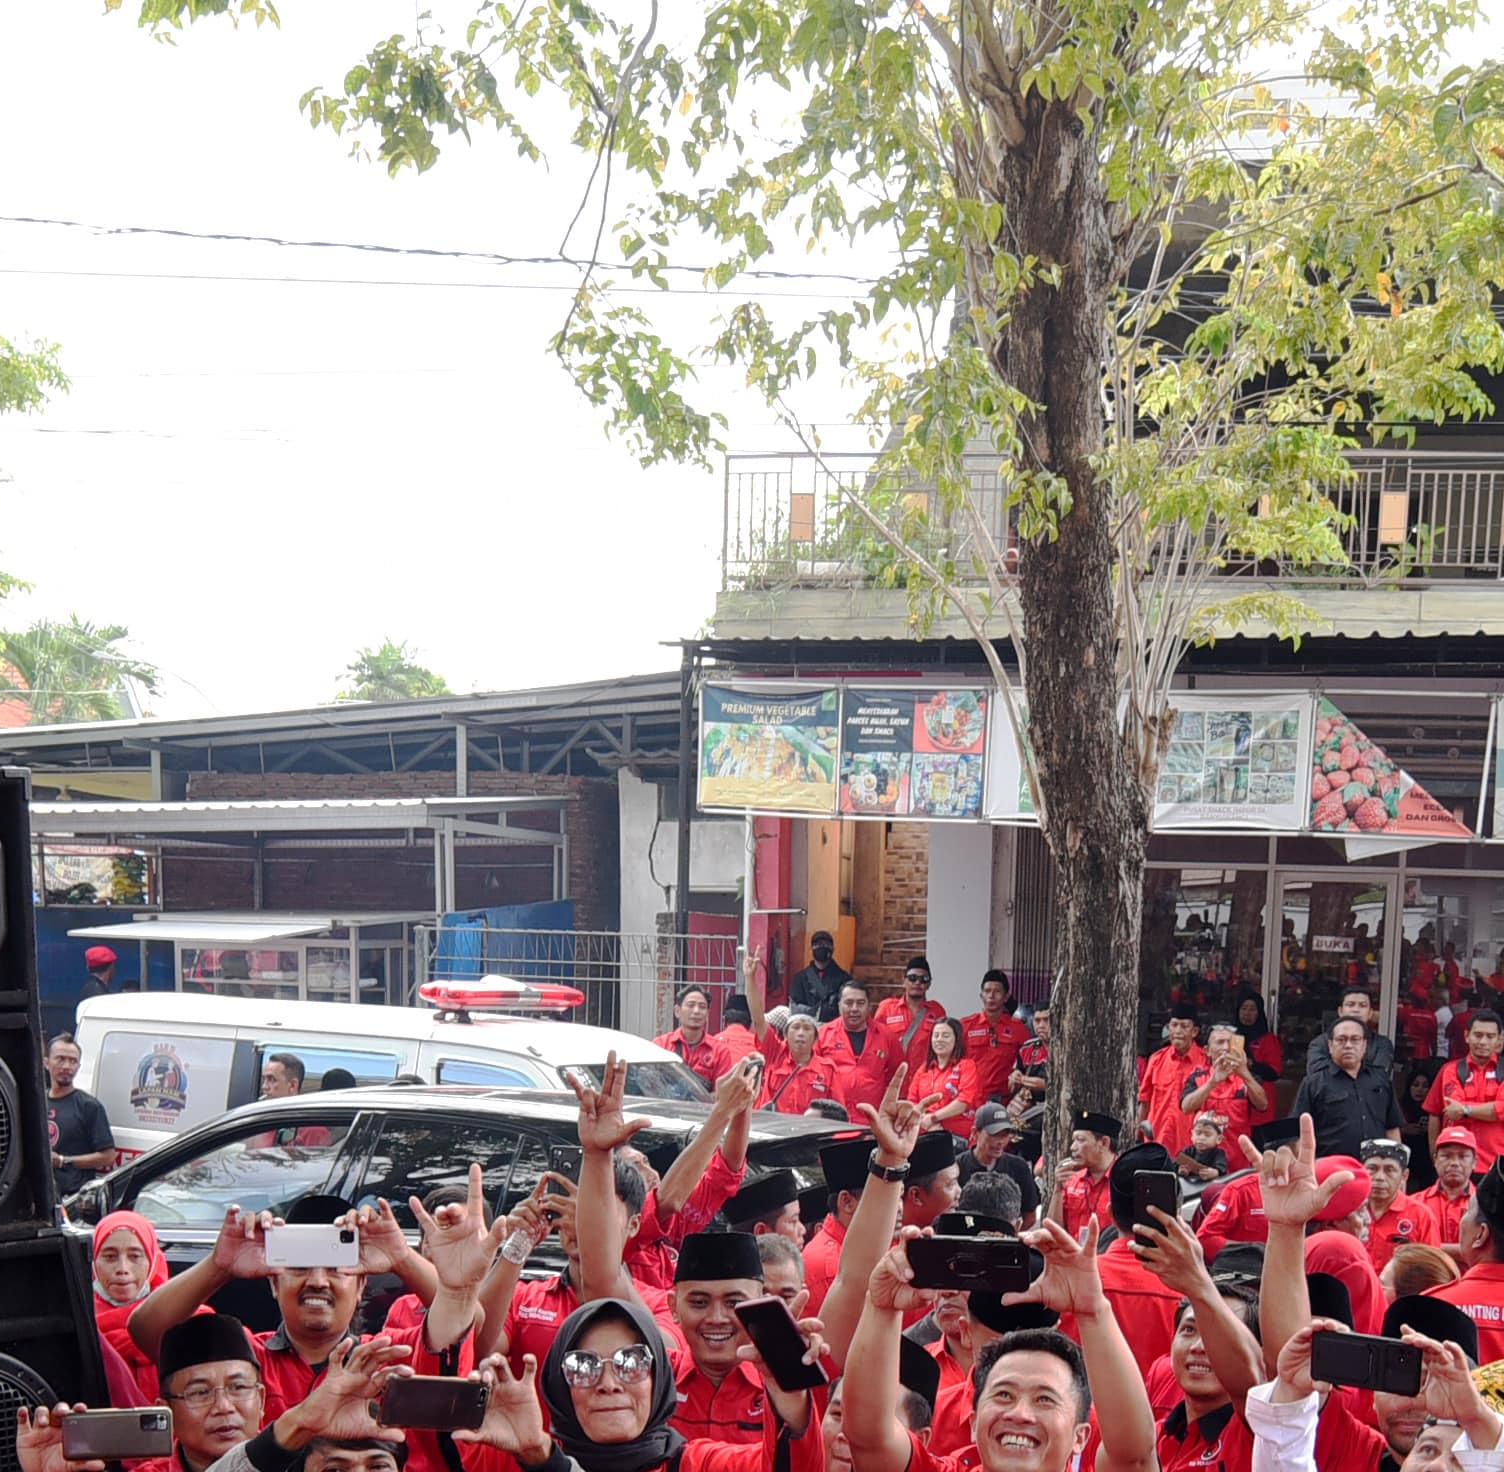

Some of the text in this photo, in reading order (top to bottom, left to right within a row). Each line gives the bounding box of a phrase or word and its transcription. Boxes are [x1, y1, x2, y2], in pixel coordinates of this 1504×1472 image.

[721, 703, 816, 716] PREMIUM VEGETABLE
[752, 715, 783, 725] SALAD
[1314, 938, 1351, 950] BUKA
